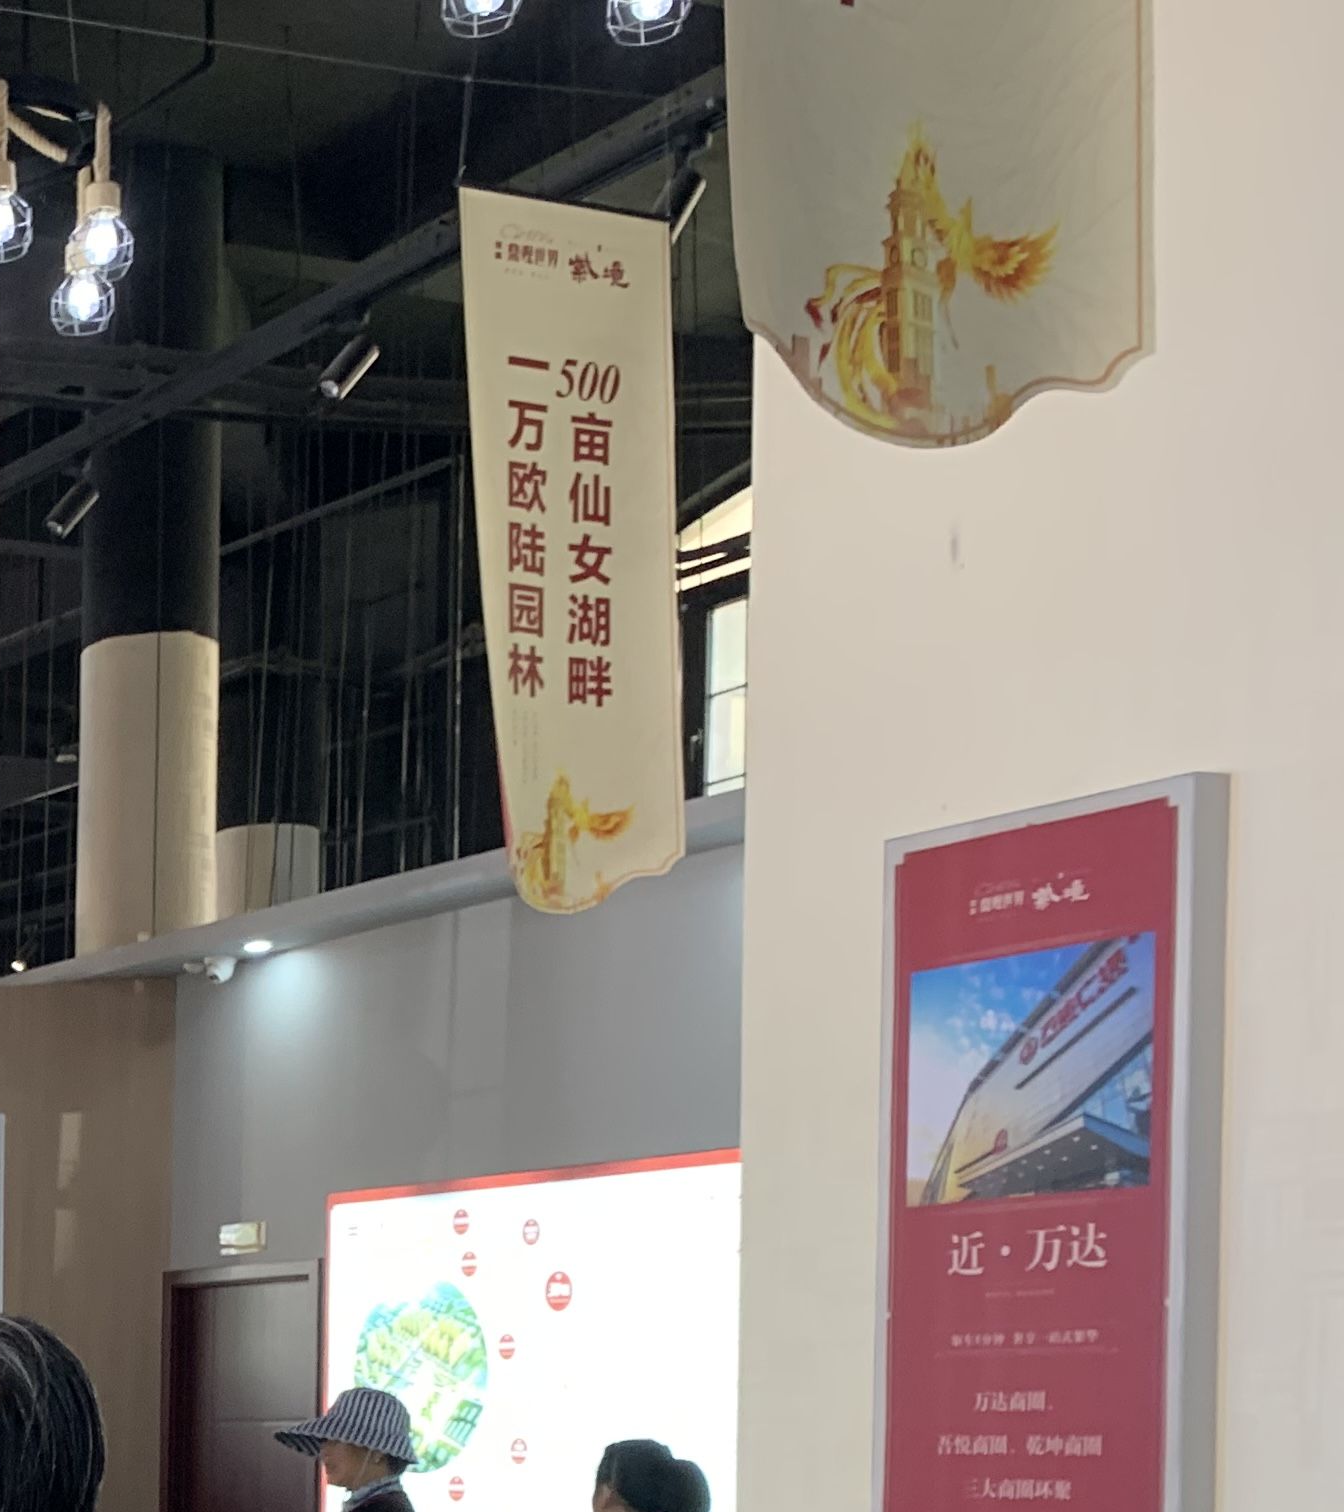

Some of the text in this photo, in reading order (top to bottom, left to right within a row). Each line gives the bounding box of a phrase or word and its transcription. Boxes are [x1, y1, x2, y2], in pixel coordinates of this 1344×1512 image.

[506, 356, 551, 699] 一万欧陆园林
[556, 358, 621, 708] 500亩仙女湖畔
[946, 1222, 1109, 1276] 近·万达
